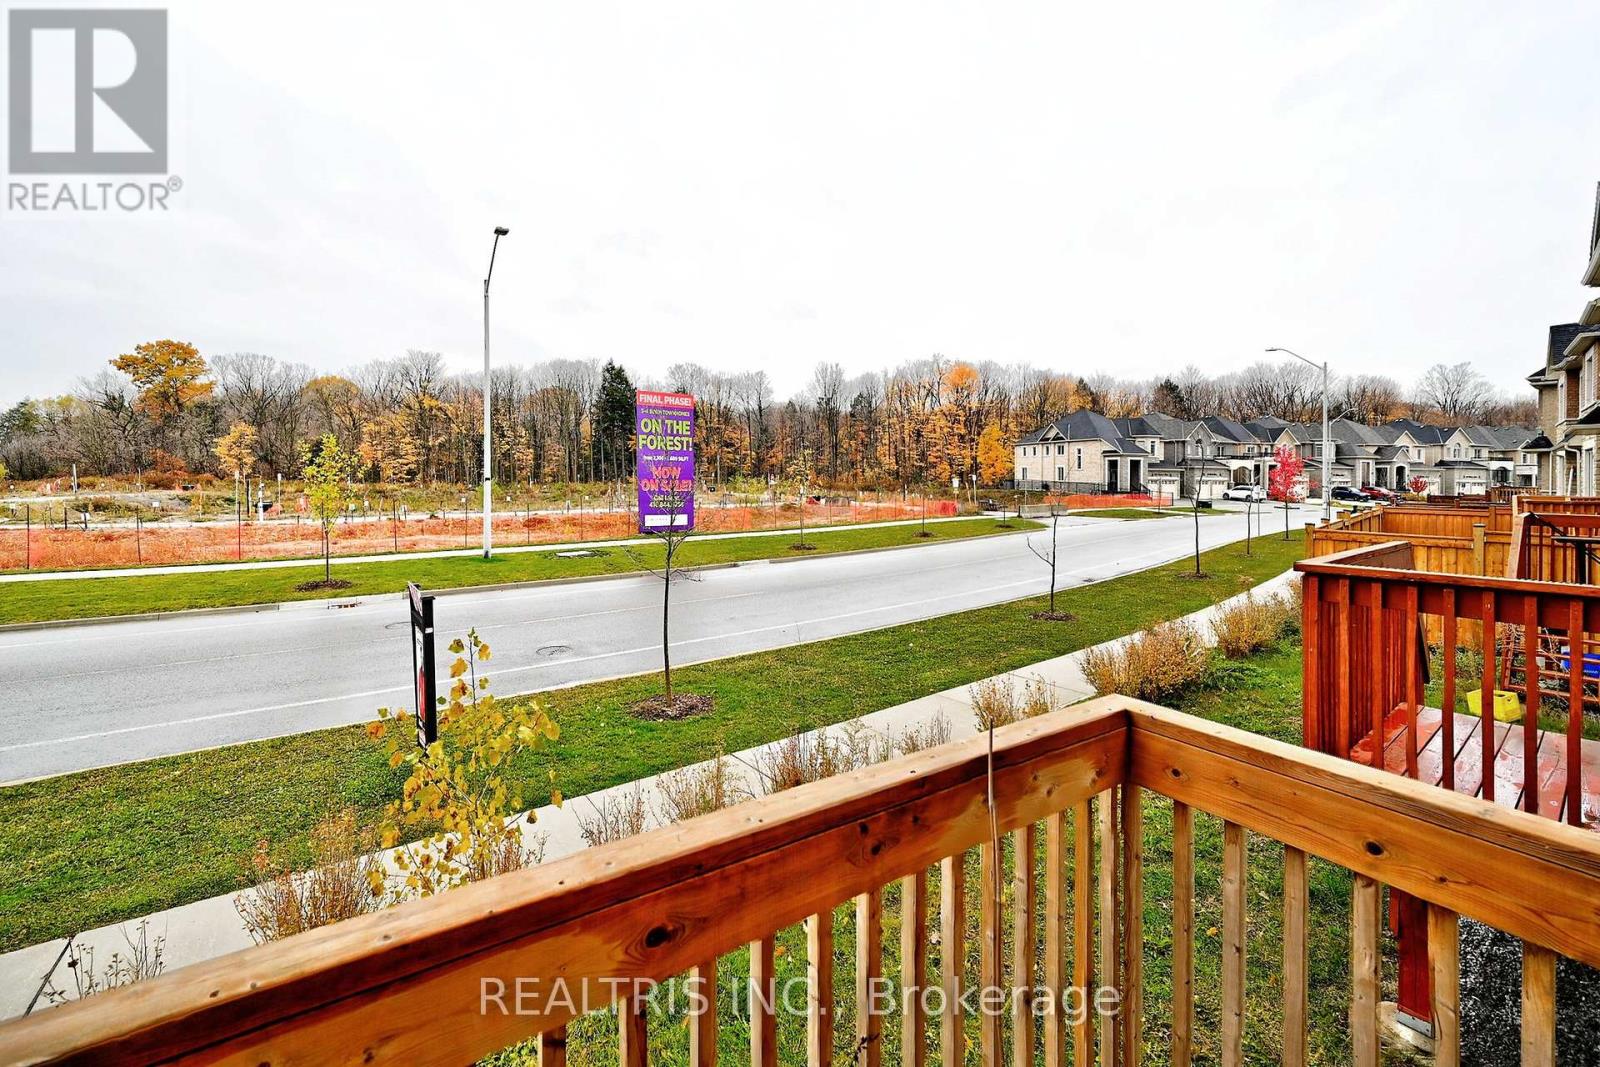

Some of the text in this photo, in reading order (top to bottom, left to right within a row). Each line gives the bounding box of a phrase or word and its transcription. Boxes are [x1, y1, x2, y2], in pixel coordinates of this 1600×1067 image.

[639, 394, 663, 404] FINAL
[641, 418, 690, 434] ON THE
[639, 435, 693, 451] FOREST!
[652, 466, 681, 479] NOW
[641, 478, 659, 491] ON
